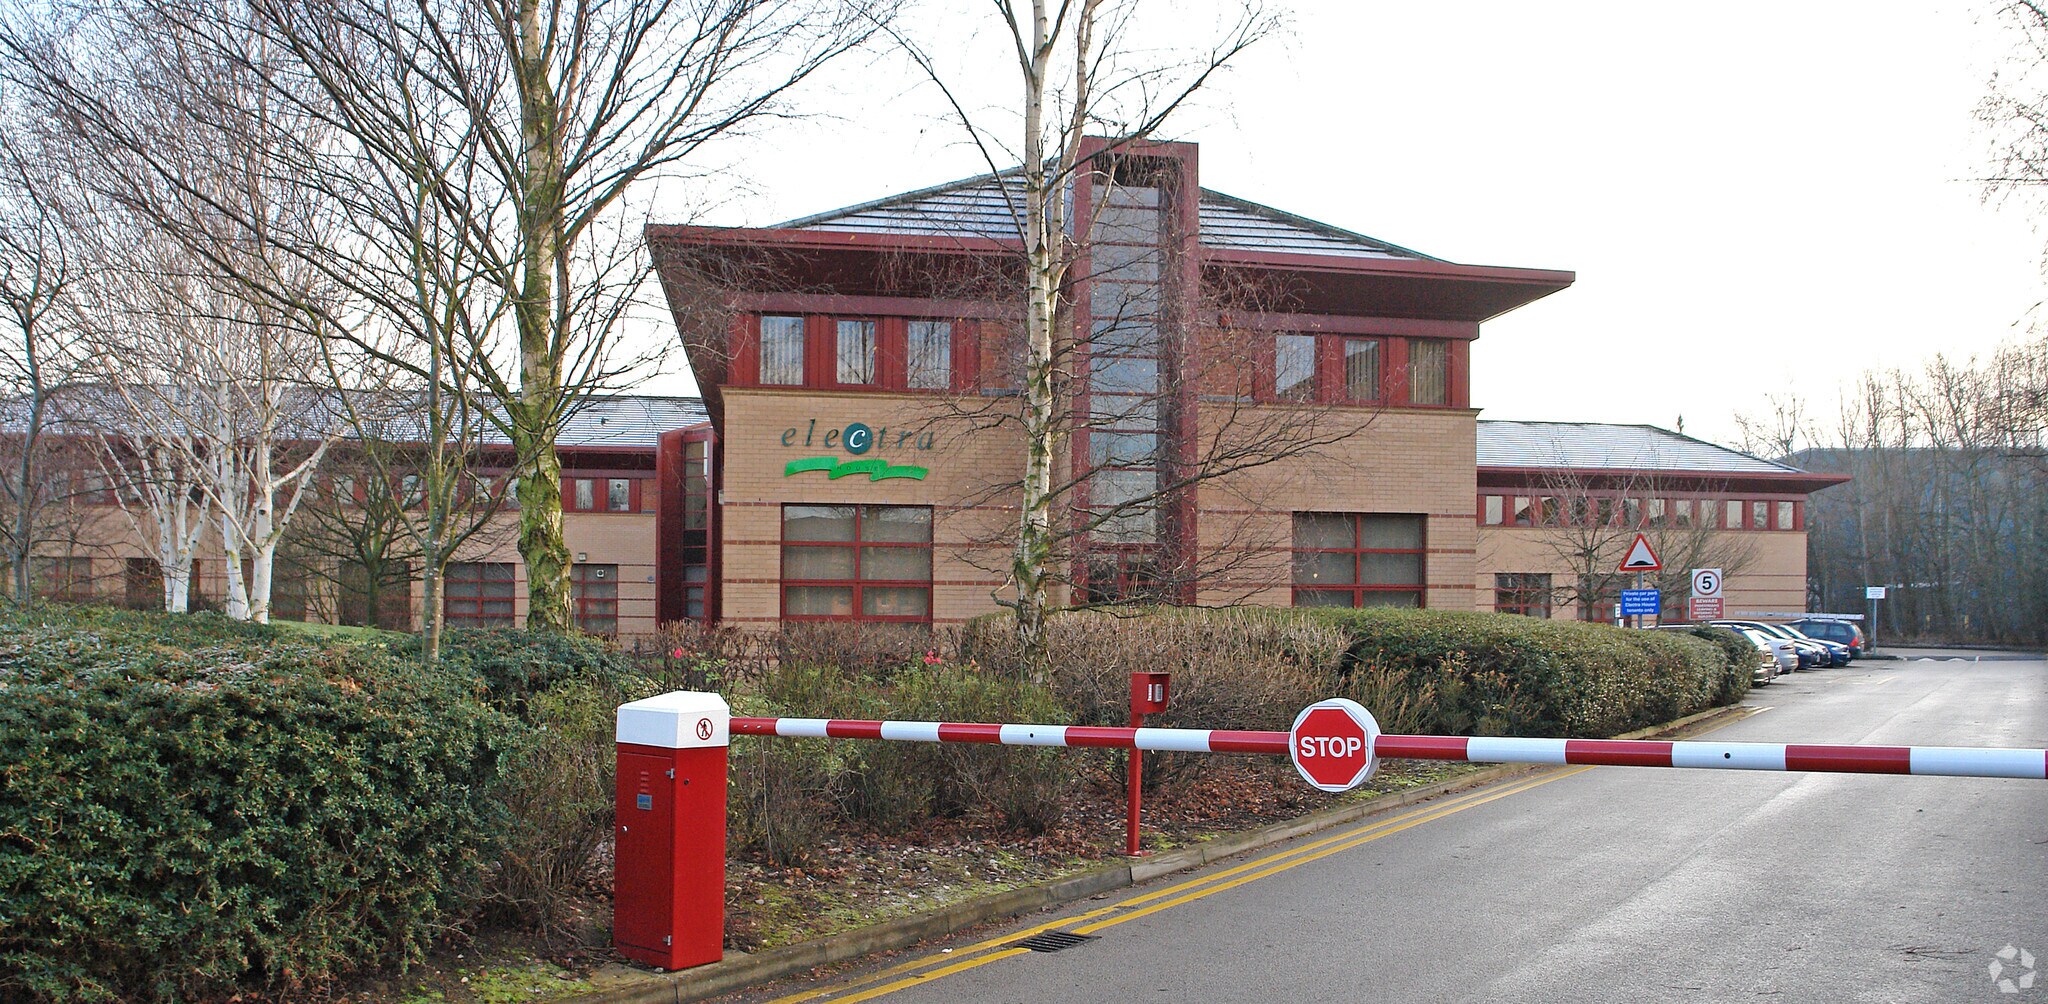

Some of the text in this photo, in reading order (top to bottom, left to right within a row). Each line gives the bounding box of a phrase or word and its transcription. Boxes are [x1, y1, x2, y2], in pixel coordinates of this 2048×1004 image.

[781, 418, 934, 451] electra
[1702, 576, 1712, 590] 5
[1300, 736, 1361, 758] STOP
